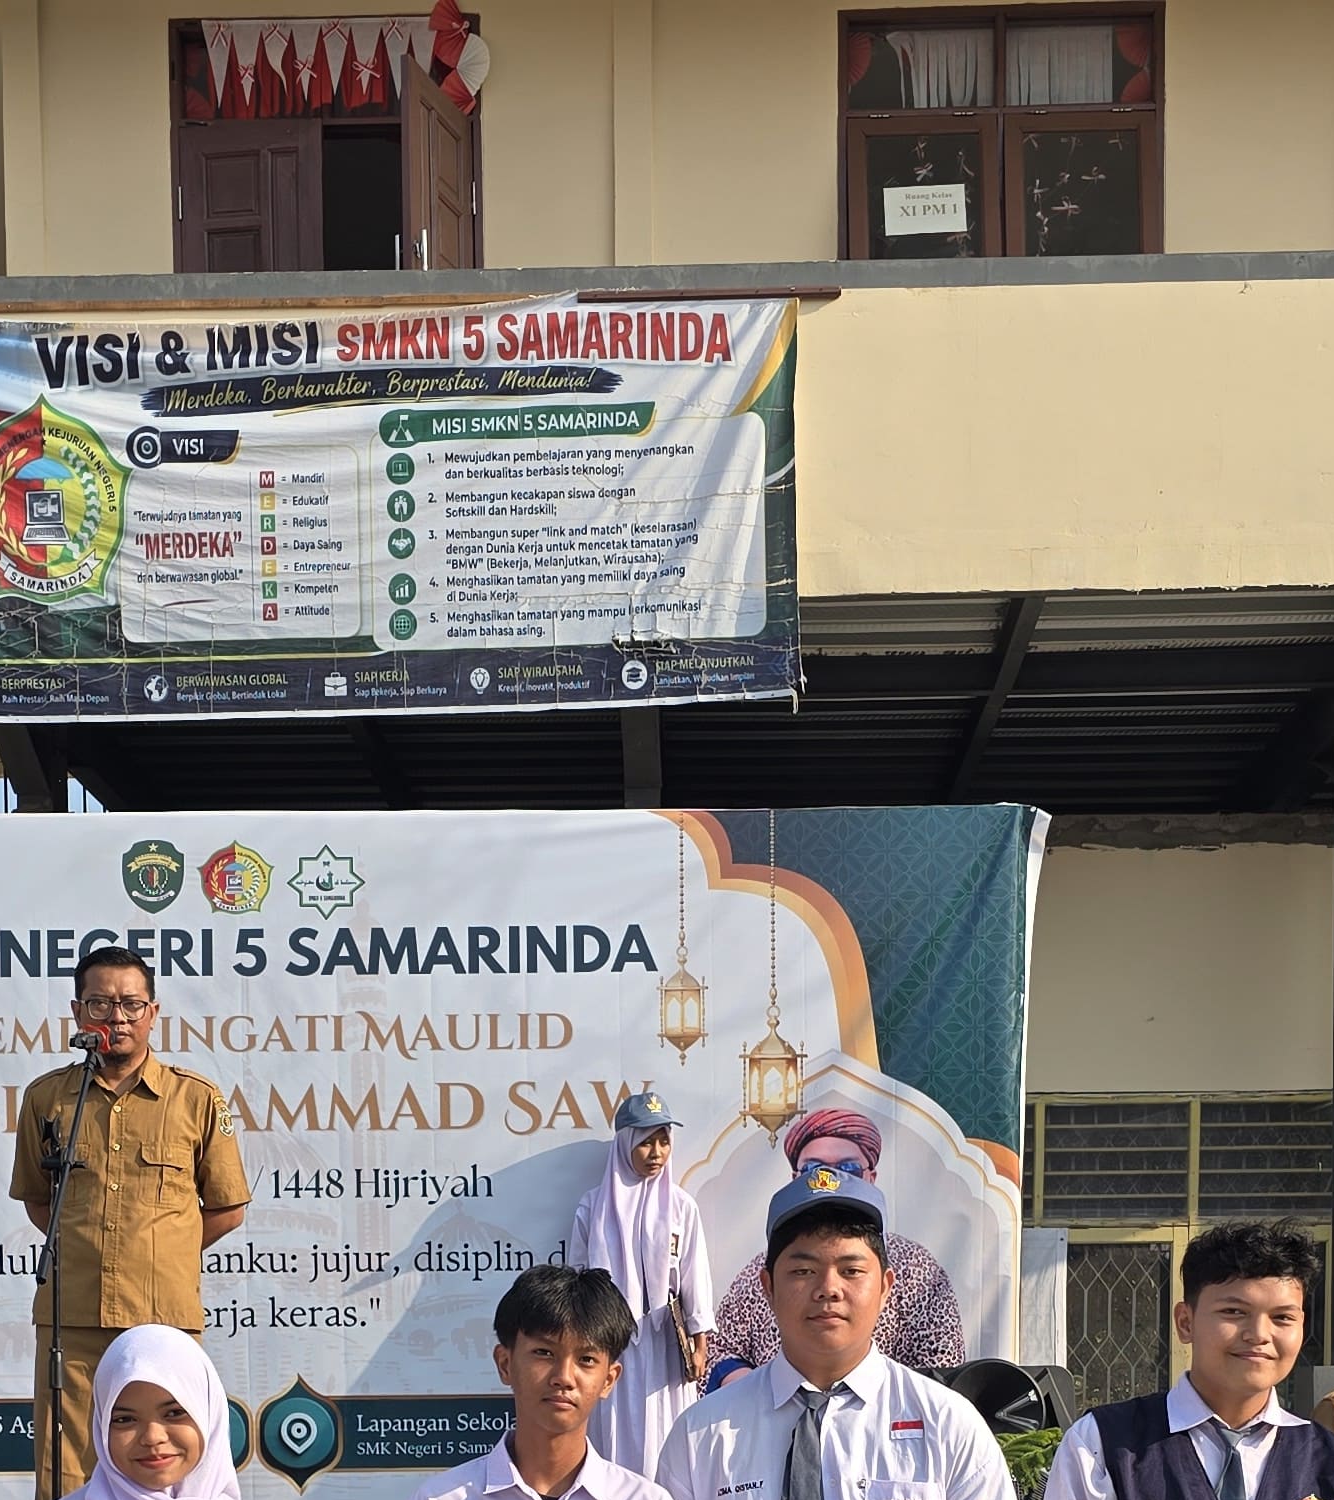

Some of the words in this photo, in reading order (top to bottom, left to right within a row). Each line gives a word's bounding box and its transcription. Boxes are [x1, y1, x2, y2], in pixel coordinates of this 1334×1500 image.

[900, 205, 917, 217] XI
[922, 203, 946, 216] PM
[953, 203, 958, 215] 1
[34, 330, 141, 390] VISI
[154, 330, 191, 376] &
[205, 320, 319, 371] MISI
[336, 316, 450, 362] SMKN
[462, 315, 485, 360] 5
[496, 311, 732, 363] SAMARINDA
[167, 386, 252, 413] Merdeka,
[261, 371, 377, 403] Berkarakter,
[386, 367, 489, 400] Berprestasi,
[498, 366, 597, 390] Mendunia!
[431, 417, 466, 436] MISI
[471, 414, 520, 433] SMKN
[523, 415, 534, 431] 5
[537, 409, 640, 430] SAMARINDA
[171, 437, 205, 456] VISI
[444, 452, 511, 467] Mewujudkan
[513, 447, 584, 466] pembelajaran
[586, 448, 612, 462] yang
[614, 443, 695, 460] menyenangkan
[48, 426, 97, 462] KEJURUAN
[94, 460, 117, 503] NEGERI
[108, 505, 117, 513] 5
[444, 467, 465, 480] dan
[466, 465, 524, 480] berkualitas
[526, 464, 570, 478] berbasis
[571, 463, 625, 479] teknologi;
[261, 474, 274, 487] M
[291, 472, 325, 484] Mandiri
[263, 495, 271, 507] E
[292, 494, 330, 507] Edukatif
[445, 490, 509, 505] Membangun
[510, 488, 566, 504] kecakapan
[567, 487, 596, 500] siswa
[598, 486, 637, 501] dengan
[188, 511, 221, 521] tamatan
[222, 511, 242, 521] yang
[445, 505, 486, 519] Softskill
[488, 503, 508, 516] dan
[509, 502, 558, 517] Hardskill;
[263, 517, 273, 529] R
[293, 516, 328, 530] Religius
[445, 527, 509, 542] Membangun
[510, 528, 540, 541] super
[541, 525, 566, 538] "link
[568, 524, 588, 537] and
[590, 523, 628, 536] match"
[630, 518, 698, 537] (keselarasan)
[135, 531, 242, 560] "MERDEKA"
[263, 540, 274, 552] D
[293, 539, 316, 552] Daya
[317, 538, 343, 552] Saing
[445, 542, 484, 558] dengan
[485, 540, 516, 554] Dunia
[517, 540, 544, 556] Kerja
[546, 540, 576, 553] untuk
[578, 538, 629, 552] mencetak
[630, 536, 673, 550] tamatan
[674, 533, 699, 550] yang
[265, 562, 274, 574] E
[293, 561, 352, 576] Entrepreneur
[445, 557, 485, 570] "BMW"
[486, 557, 533, 571] (Bekerja,
[534, 554, 601, 569] Melanjutkan,
[603, 551, 665, 567] Wirausaha);
[9, 571, 87, 593] SAMARINDA
[155, 570, 210, 584] berwawasan
[446, 575, 515, 590] Menghasilkan
[517, 574, 559, 586] tamatan
[560, 573, 586, 586] yang
[587, 568, 631, 583] memiliki
[633, 567, 658, 583] daya
[659, 564, 686, 579] saing
[265, 584, 276, 597] K
[294, 582, 339, 596] Kompeten
[446, 590, 457, 603] di
[458, 589, 488, 602] Dunia
[265, 606, 276, 619] A
[294, 605, 330, 617] Attitude
[447, 610, 515, 626] Menghasilkan
[517, 608, 558, 621] tamatan
[559, 609, 586, 622] yang
[587, 606, 626, 621] mampu
[446, 625, 478, 639] dalam
[479, 624, 515, 637] bahasa
[517, 623, 546, 639] asing.
[521, 664, 583, 677] WIRAUSAHA
[1, 676, 66, 690] BERPRESTASI
[175, 673, 247, 689] BERWAWASAN
[248, 672, 289, 686] GLOBAL
[232, 928, 267, 977] 5
[284, 924, 658, 976] SAMARINDA
[355, 1010, 574, 1061] MAULID
[271, 1167, 345, 1199] 1448
[355, 1163, 494, 1209] Hijriyah
[308, 1243, 401, 1283] jujur,
[413, 1241, 535, 1283] disiplin
[268, 1296, 381, 1328] keras."
[356, 1413, 451, 1438] Lapangan
[356, 1441, 392, 1456] SMK
[395, 1441, 442, 1459] Negeri
[446, 1441, 454, 1455] 5
